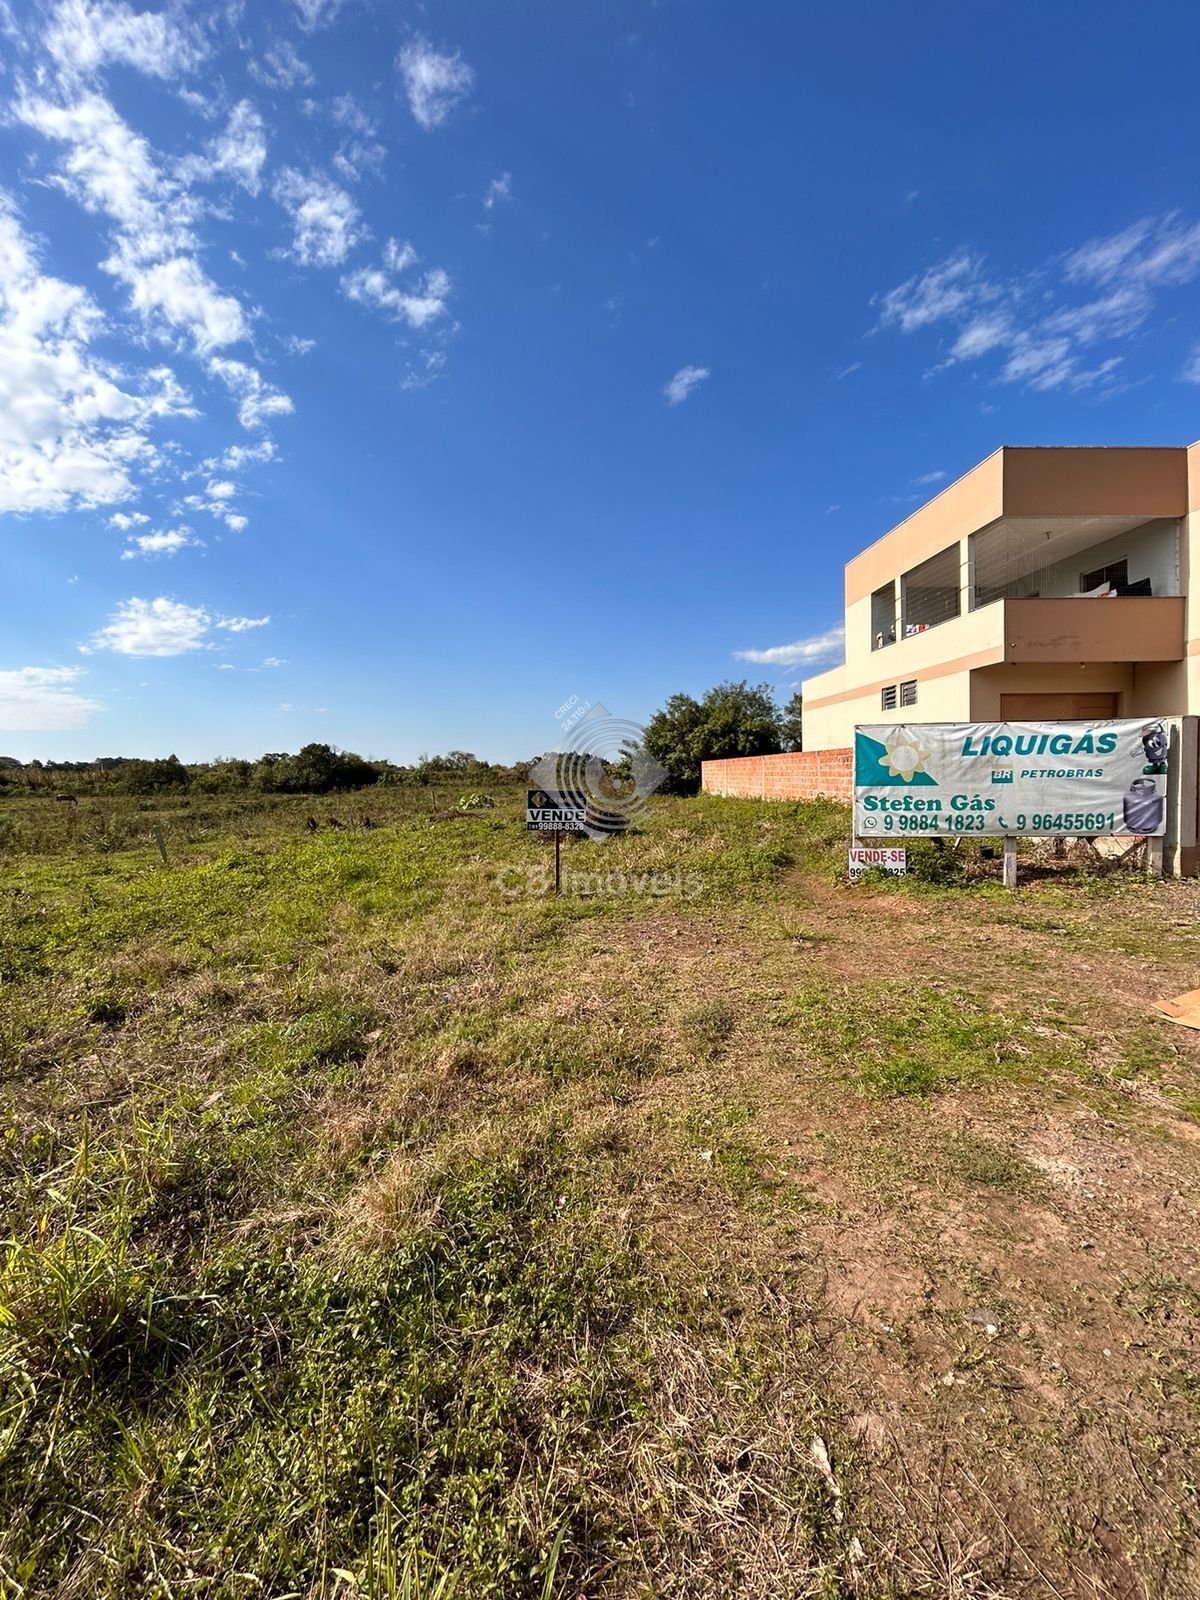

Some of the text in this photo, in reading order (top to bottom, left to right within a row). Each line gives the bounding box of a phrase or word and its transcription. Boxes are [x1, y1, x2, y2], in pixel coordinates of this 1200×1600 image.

[961, 729, 1118, 757] LIQUIGÁS
[993, 770, 1012, 779] BR
[1020, 768, 1104, 779] PETROBRAS
[863, 794, 996, 811] Stefen Gás
[530, 810, 585, 821] VENDE
[884, 814, 985, 830] 9 9884 1823
[1017, 812, 1115, 831] 9 96455691
[850, 850, 905, 862] VENDE-SE
